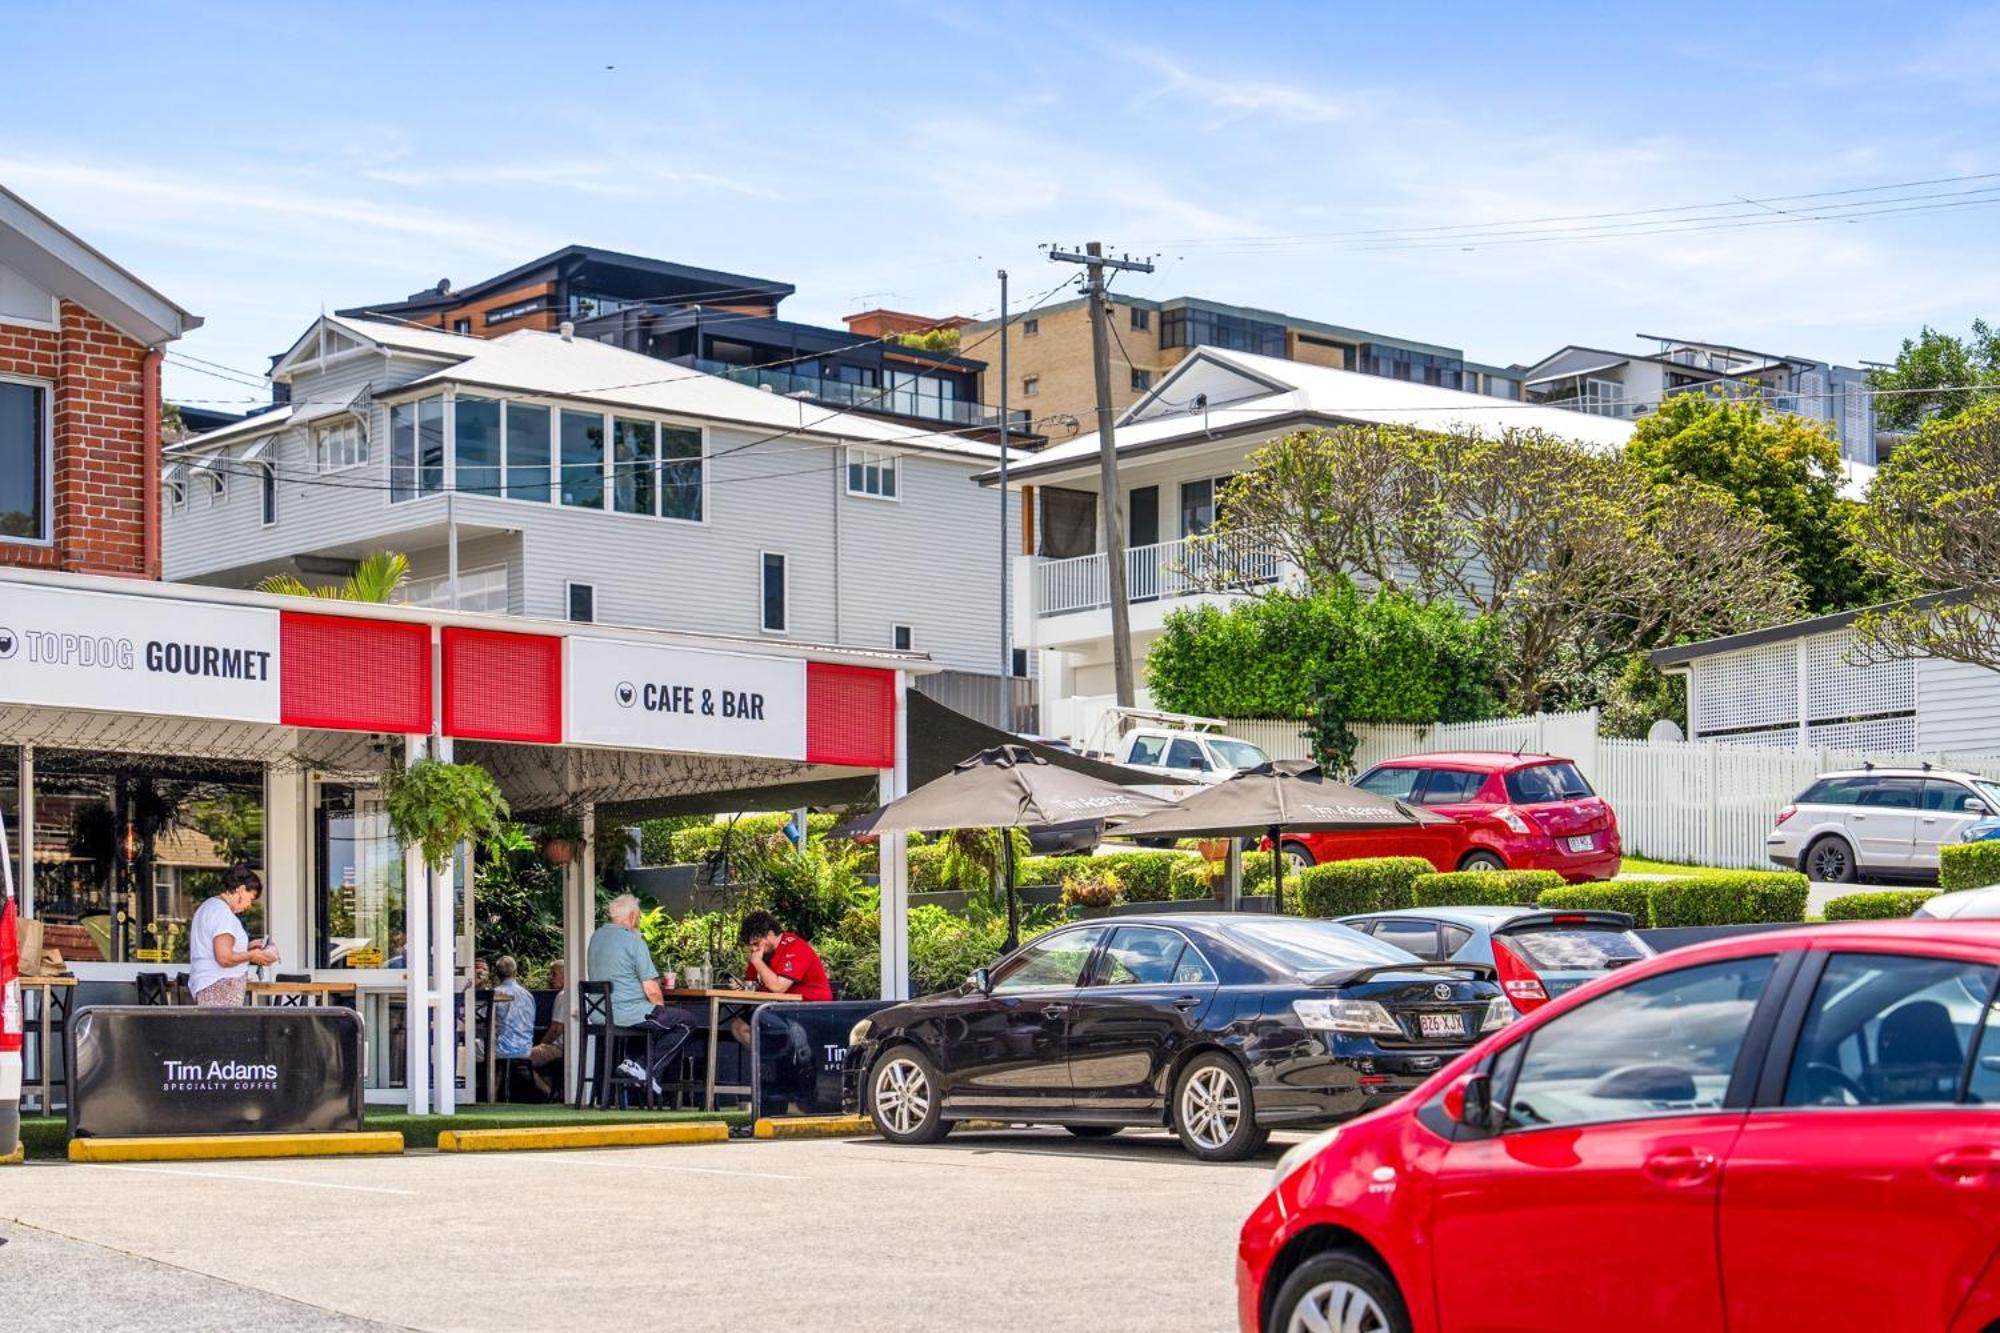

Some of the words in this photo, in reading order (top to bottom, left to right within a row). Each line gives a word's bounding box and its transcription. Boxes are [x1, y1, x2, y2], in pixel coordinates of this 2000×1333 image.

[25, 630, 134, 669] TOPDOG
[146, 640, 271, 681] GOURMET
[643, 683, 694, 714] CAFE
[701, 688, 714, 716] &
[722, 690, 764, 720] BAR
[163, 1060, 202, 1080] Tim
[206, 1060, 278, 1080] Adams
[163, 1083, 227, 1091] SPECIALTY
[233, 1082, 278, 1090] COFFEE
